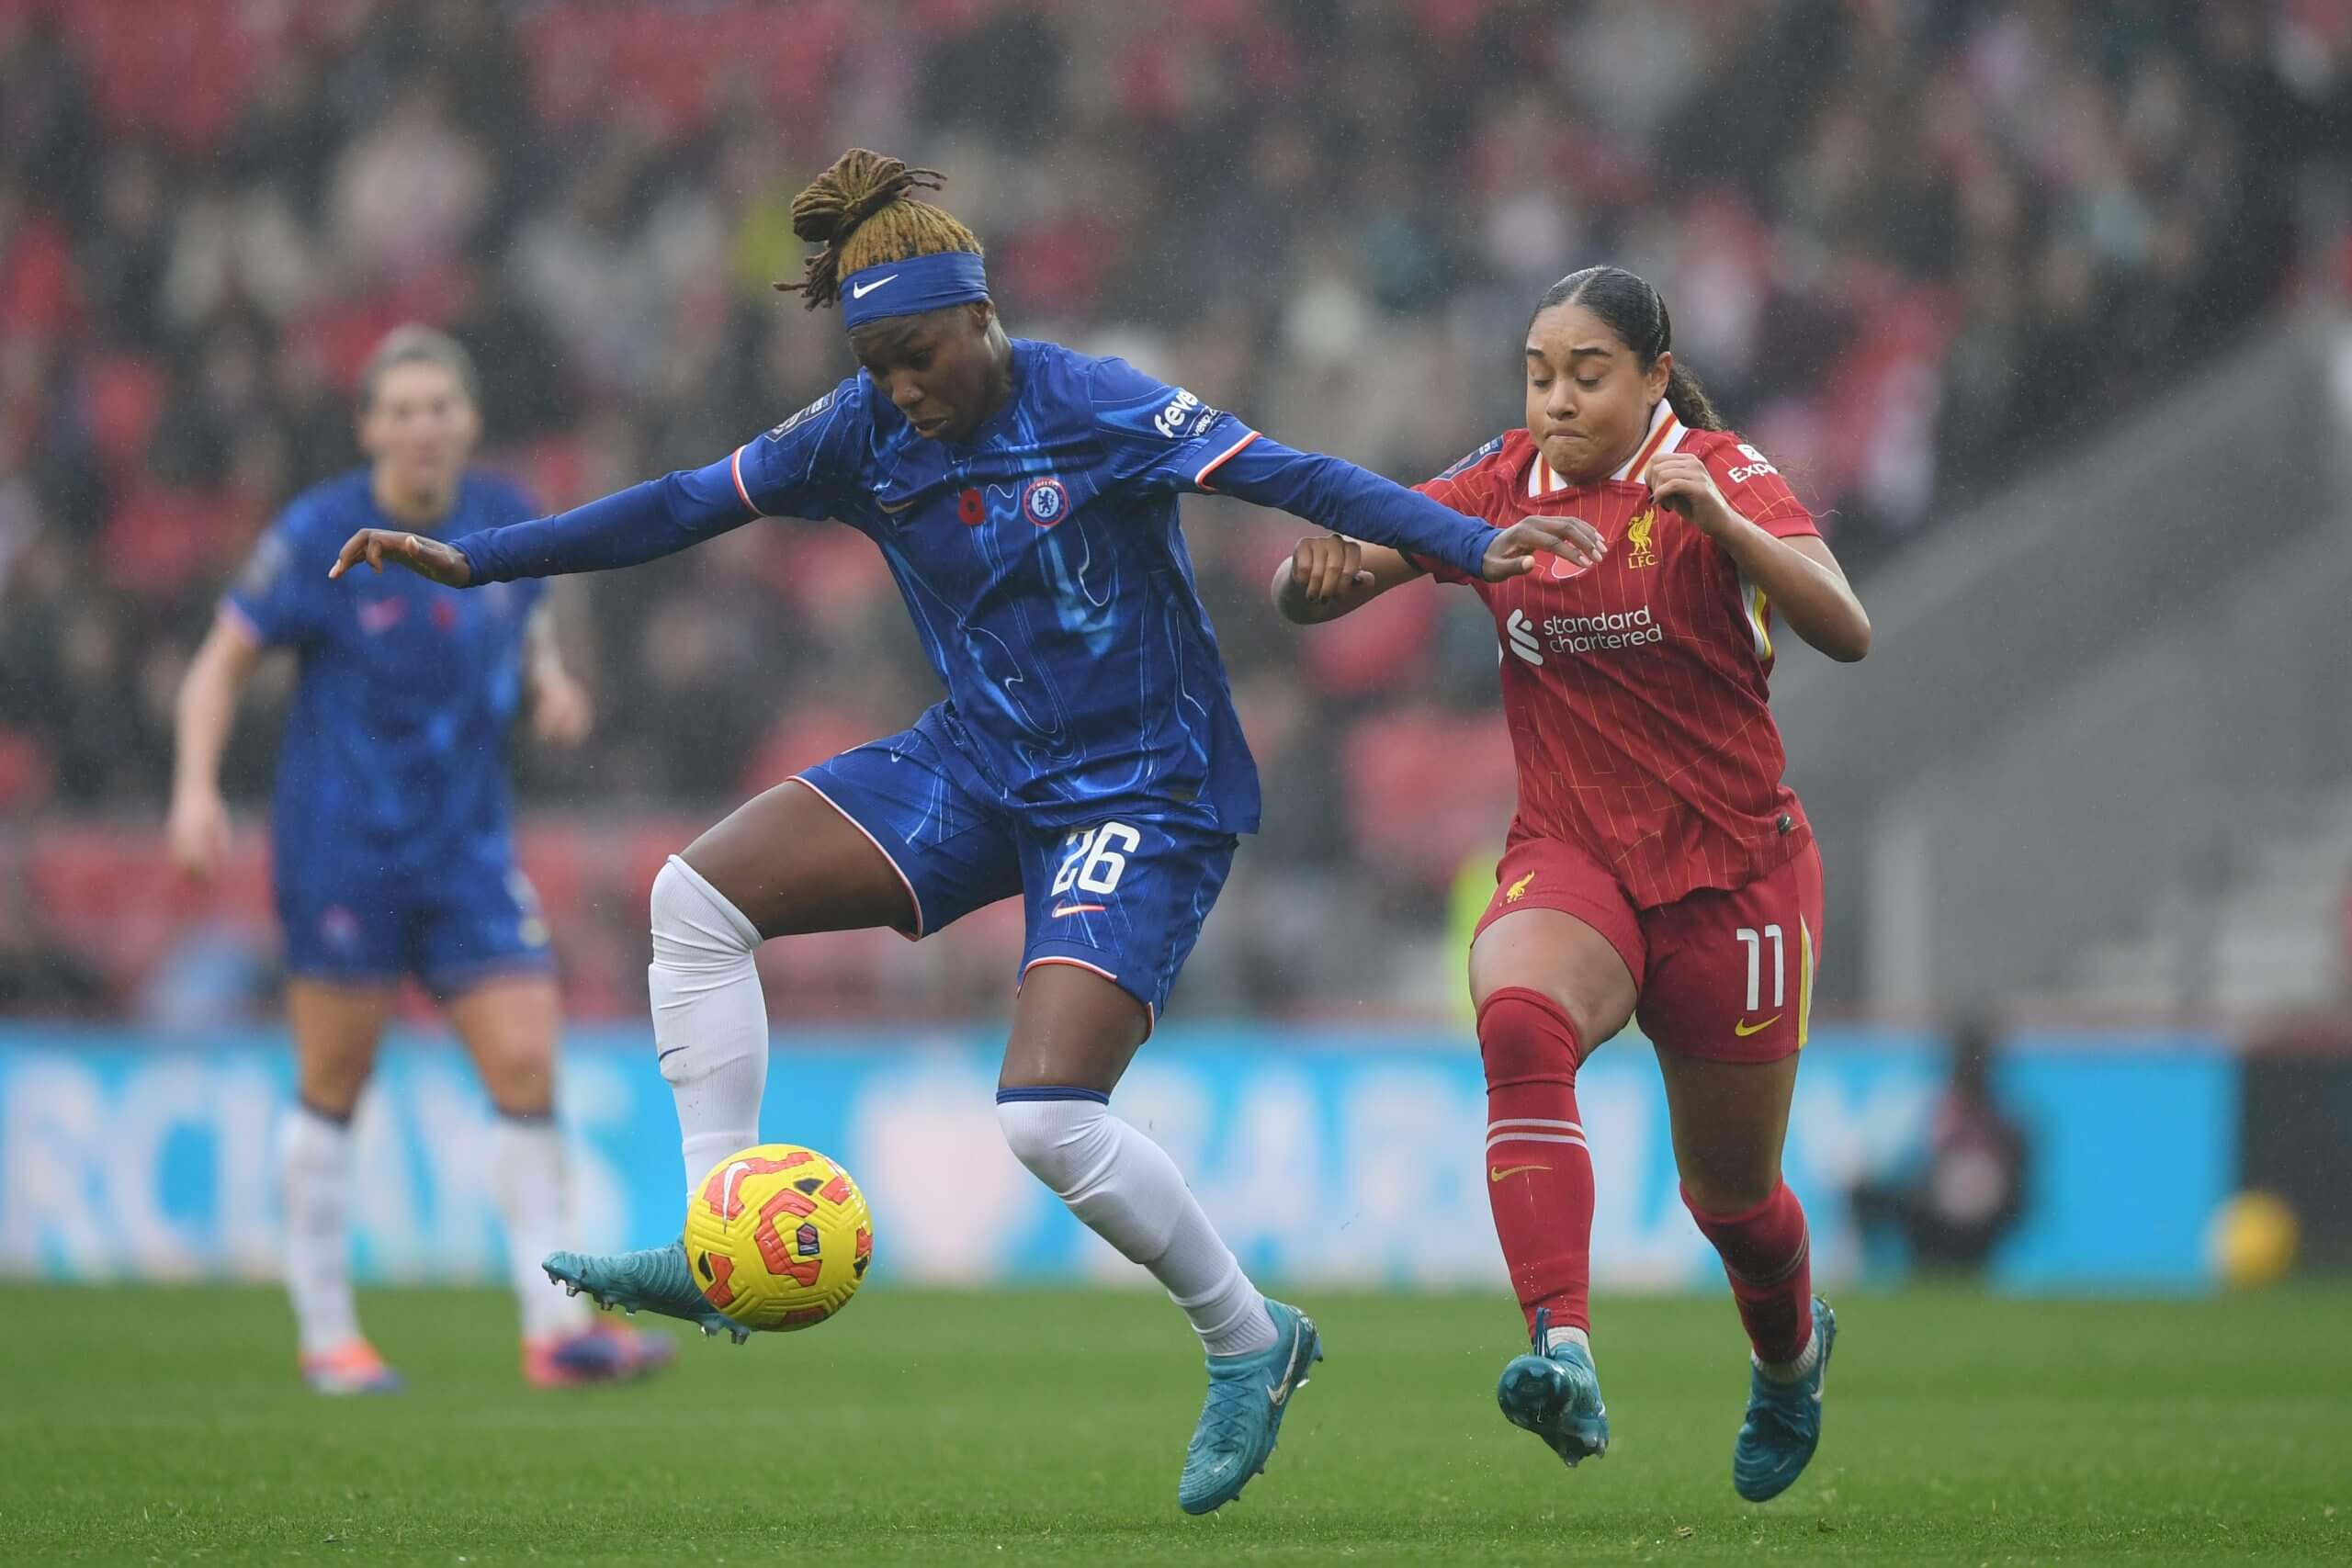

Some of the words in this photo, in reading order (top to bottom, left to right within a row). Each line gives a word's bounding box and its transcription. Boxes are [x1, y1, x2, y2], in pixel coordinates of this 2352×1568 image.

[1544, 605, 1651, 636] standard
[1549, 624, 1663, 654] chartered
[1051, 821, 1141, 897] 26
[1736, 924, 1784, 1011] 11
